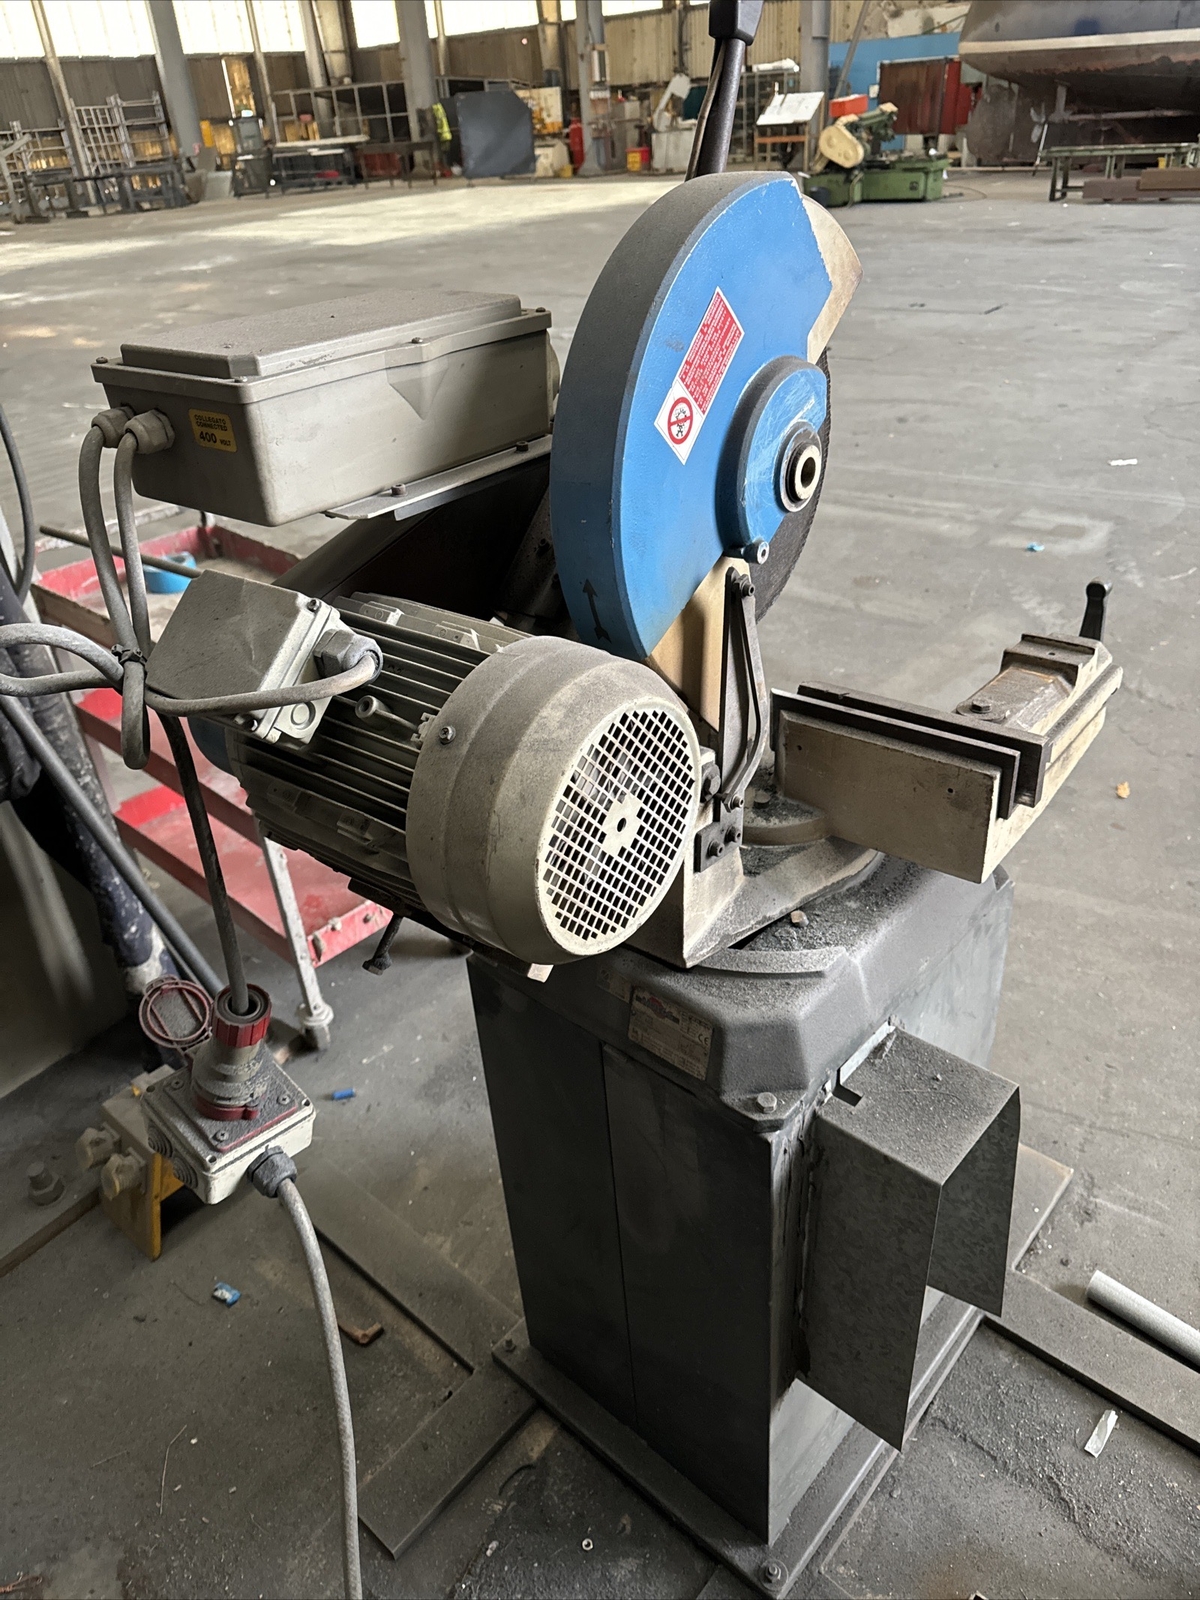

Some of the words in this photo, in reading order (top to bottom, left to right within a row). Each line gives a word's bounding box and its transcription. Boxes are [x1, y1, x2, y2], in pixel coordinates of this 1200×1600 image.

[194, 414, 226, 425] COLLEGATO
[196, 421, 227, 431] CONNECTED
[200, 431, 217, 443] 400
